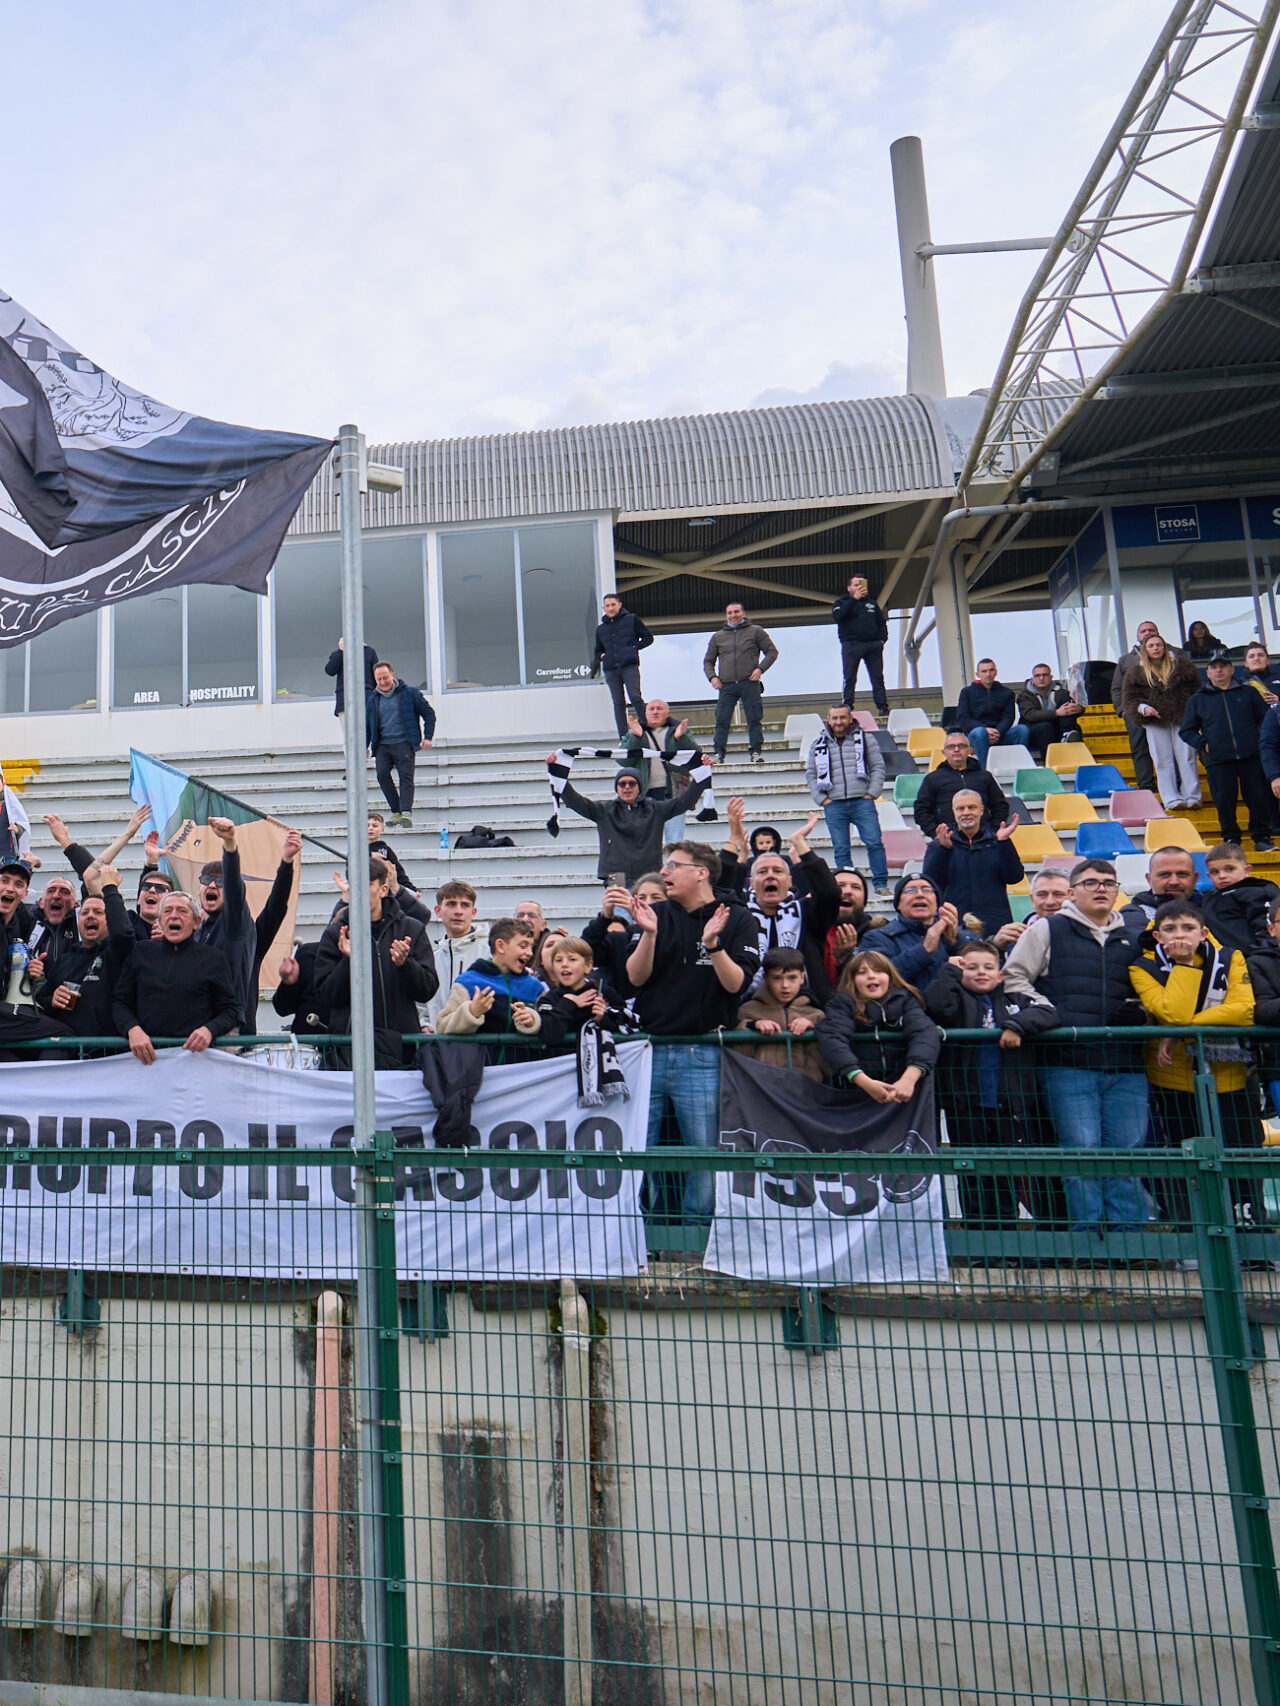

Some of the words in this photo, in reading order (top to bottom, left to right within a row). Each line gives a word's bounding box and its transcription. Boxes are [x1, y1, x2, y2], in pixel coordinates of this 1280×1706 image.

[1159, 518, 1197, 529] STOSA
[535, 667, 572, 676] Carrefour
[133, 691, 160, 704] AREA
[189, 685, 256, 701] HOSPITALITY
[247, 1122, 310, 1200] IL
